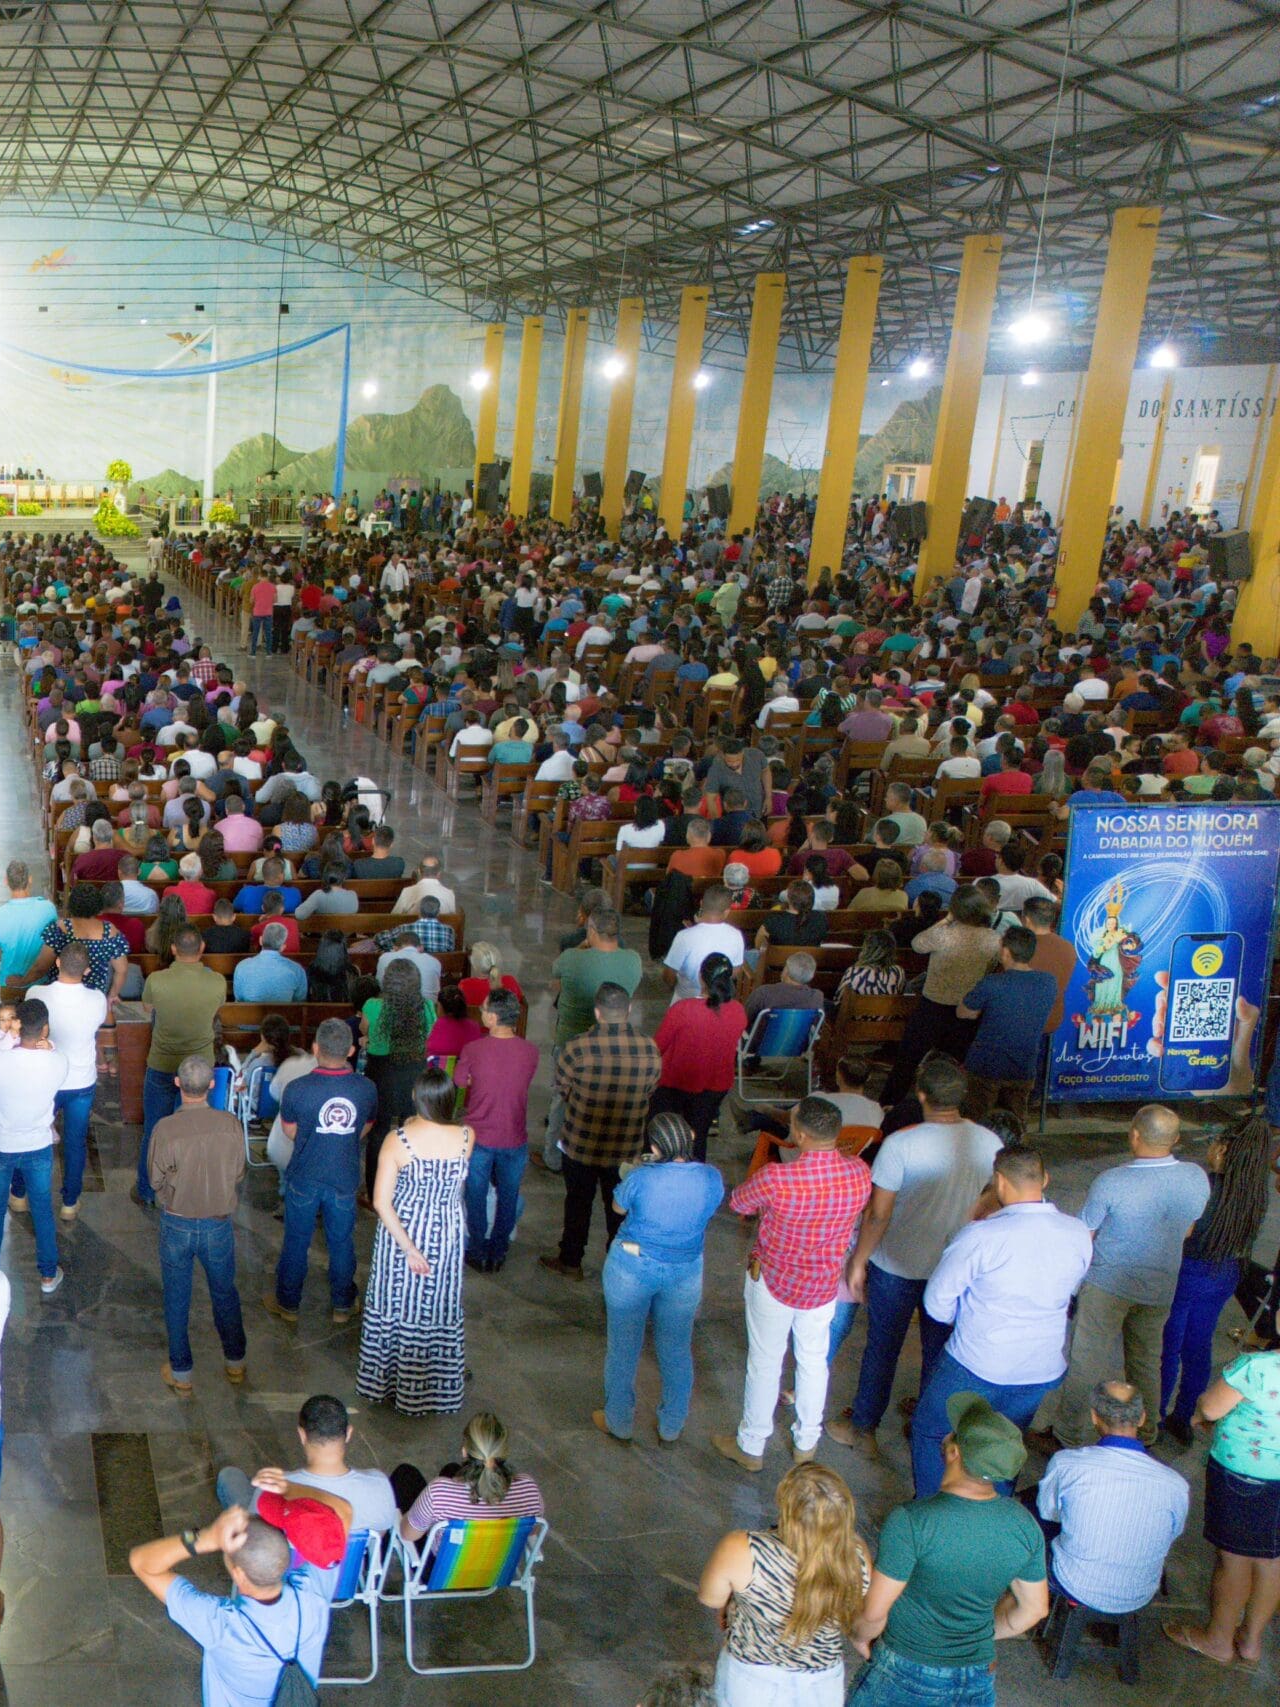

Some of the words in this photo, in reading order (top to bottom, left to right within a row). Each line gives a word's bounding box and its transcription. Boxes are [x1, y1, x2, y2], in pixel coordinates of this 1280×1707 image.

[1138, 399, 1161, 418] DO
[1173, 390, 1278, 418] SANTÍSSI
[1096, 815, 1161, 833] NOSSA
[1165, 813, 1259, 832] SENHORA
[1099, 835, 1162, 849] D'ABADIA
[1165, 835, 1188, 848] DO
[1078, 1020, 1128, 1049] WIFI
[1055, 1041, 1083, 1064] dos
[1081, 1039, 1154, 1073] Devotos
[1167, 1048, 1200, 1057] Navegue
[1188, 1055, 1218, 1066] Grátis
[1058, 1074, 1083, 1085] Faça
[1085, 1075, 1103, 1083] seu
[1104, 1073, 1150, 1083] cadastro
